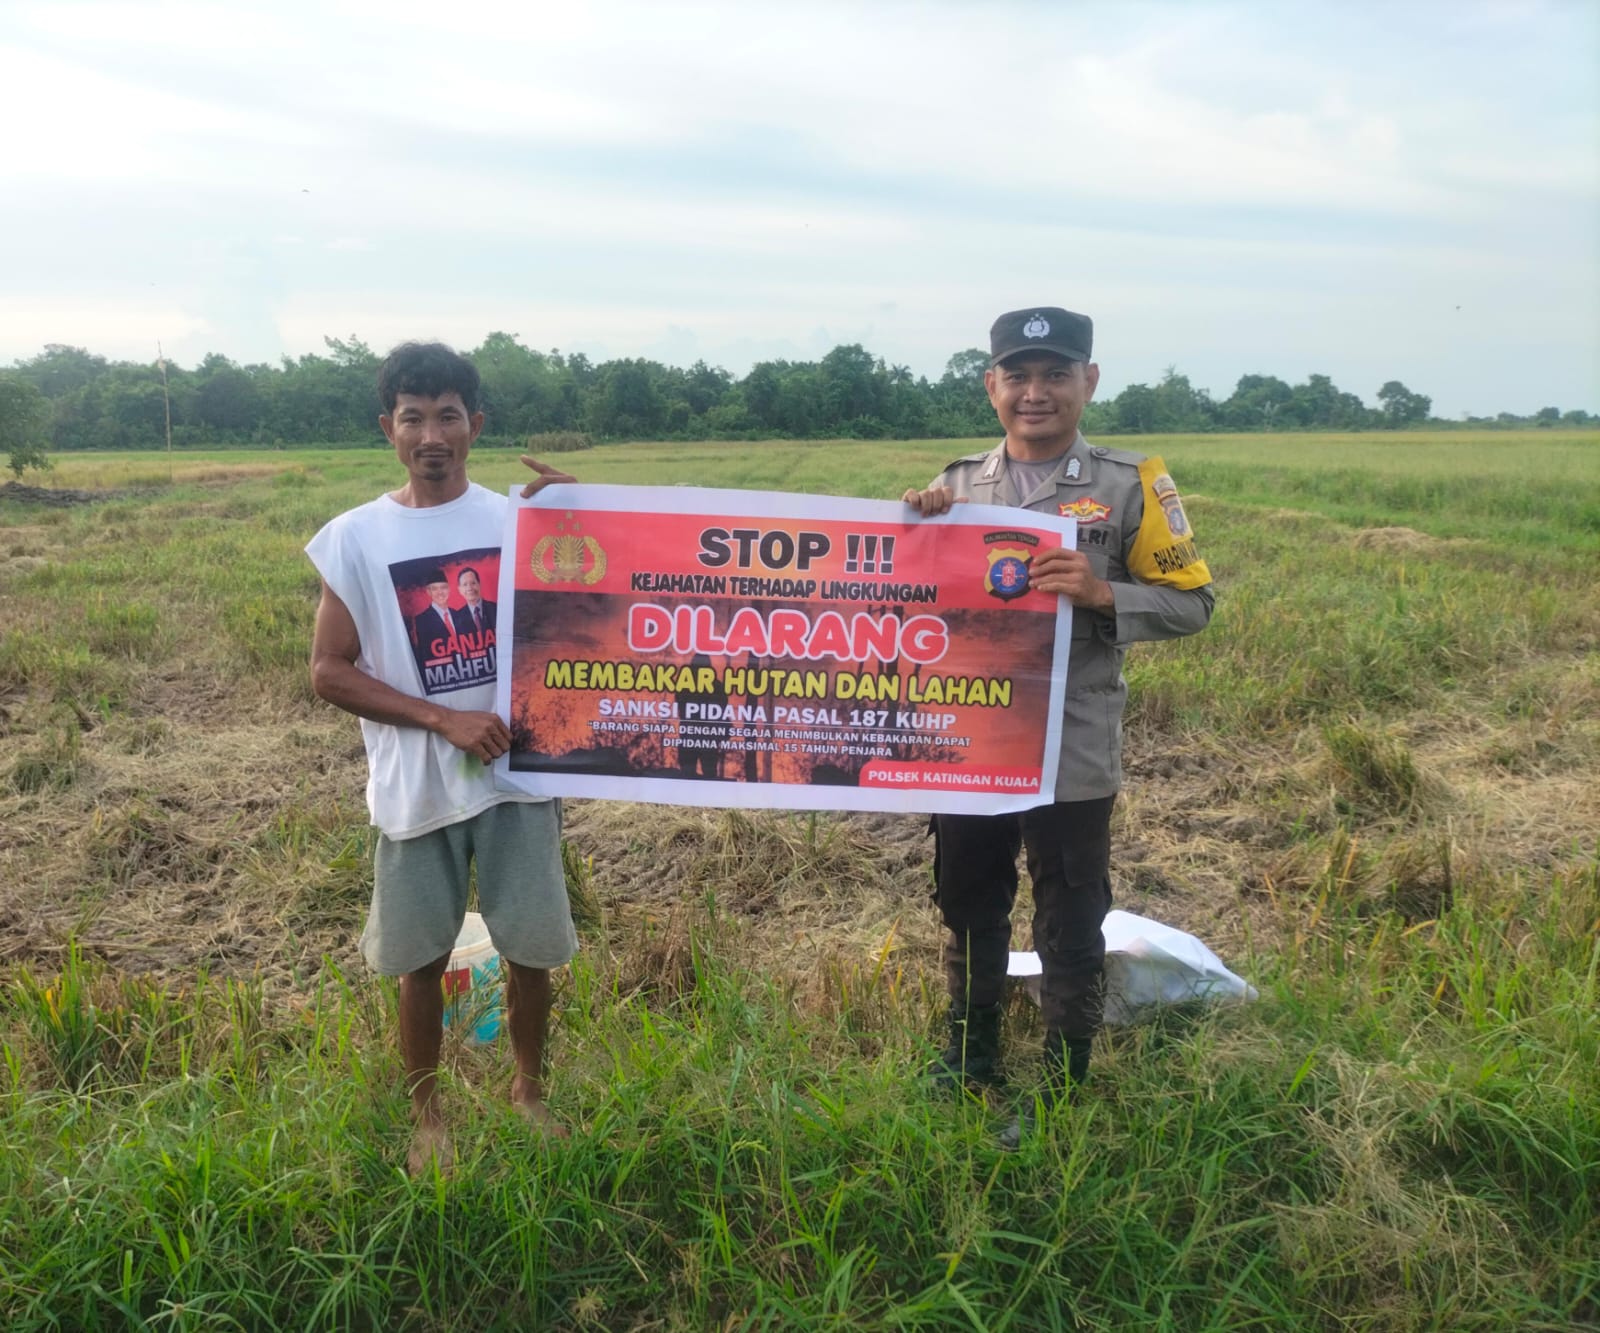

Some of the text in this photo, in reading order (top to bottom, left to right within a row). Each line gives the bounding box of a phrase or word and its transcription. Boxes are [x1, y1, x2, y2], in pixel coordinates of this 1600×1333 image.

[698, 528, 896, 575] STOP !!!
[1077, 527, 1108, 545] LRI
[631, 573, 937, 604] KEJAHATAN TERHADAP LINGKUNGAN
[431, 628, 497, 659] GANJA
[627, 603, 949, 665] DILARANG
[425, 647, 497, 686] MAHFU
[544, 659, 1012, 708] MEMBAKAR HUTAN DAN LAHAN
[598, 698, 957, 730] SANKSI PIDANA PASAL 187 KUHP
[642, 723, 676, 734] SIAPA
[679, 725, 726, 737] DENGAN
[730, 727, 771, 738] SEGAJA
[774, 729, 859, 742] MENIMBULKAN
[862, 733, 932, 745] KEBAKARAN
[934, 736, 971, 747] DAPAT
[663, 738, 893, 758] DIPIDANA MAKSIMAL 15 TAHUN PENJARA
[867, 770, 1039, 788] POLSEK KATINGAN KUALA
